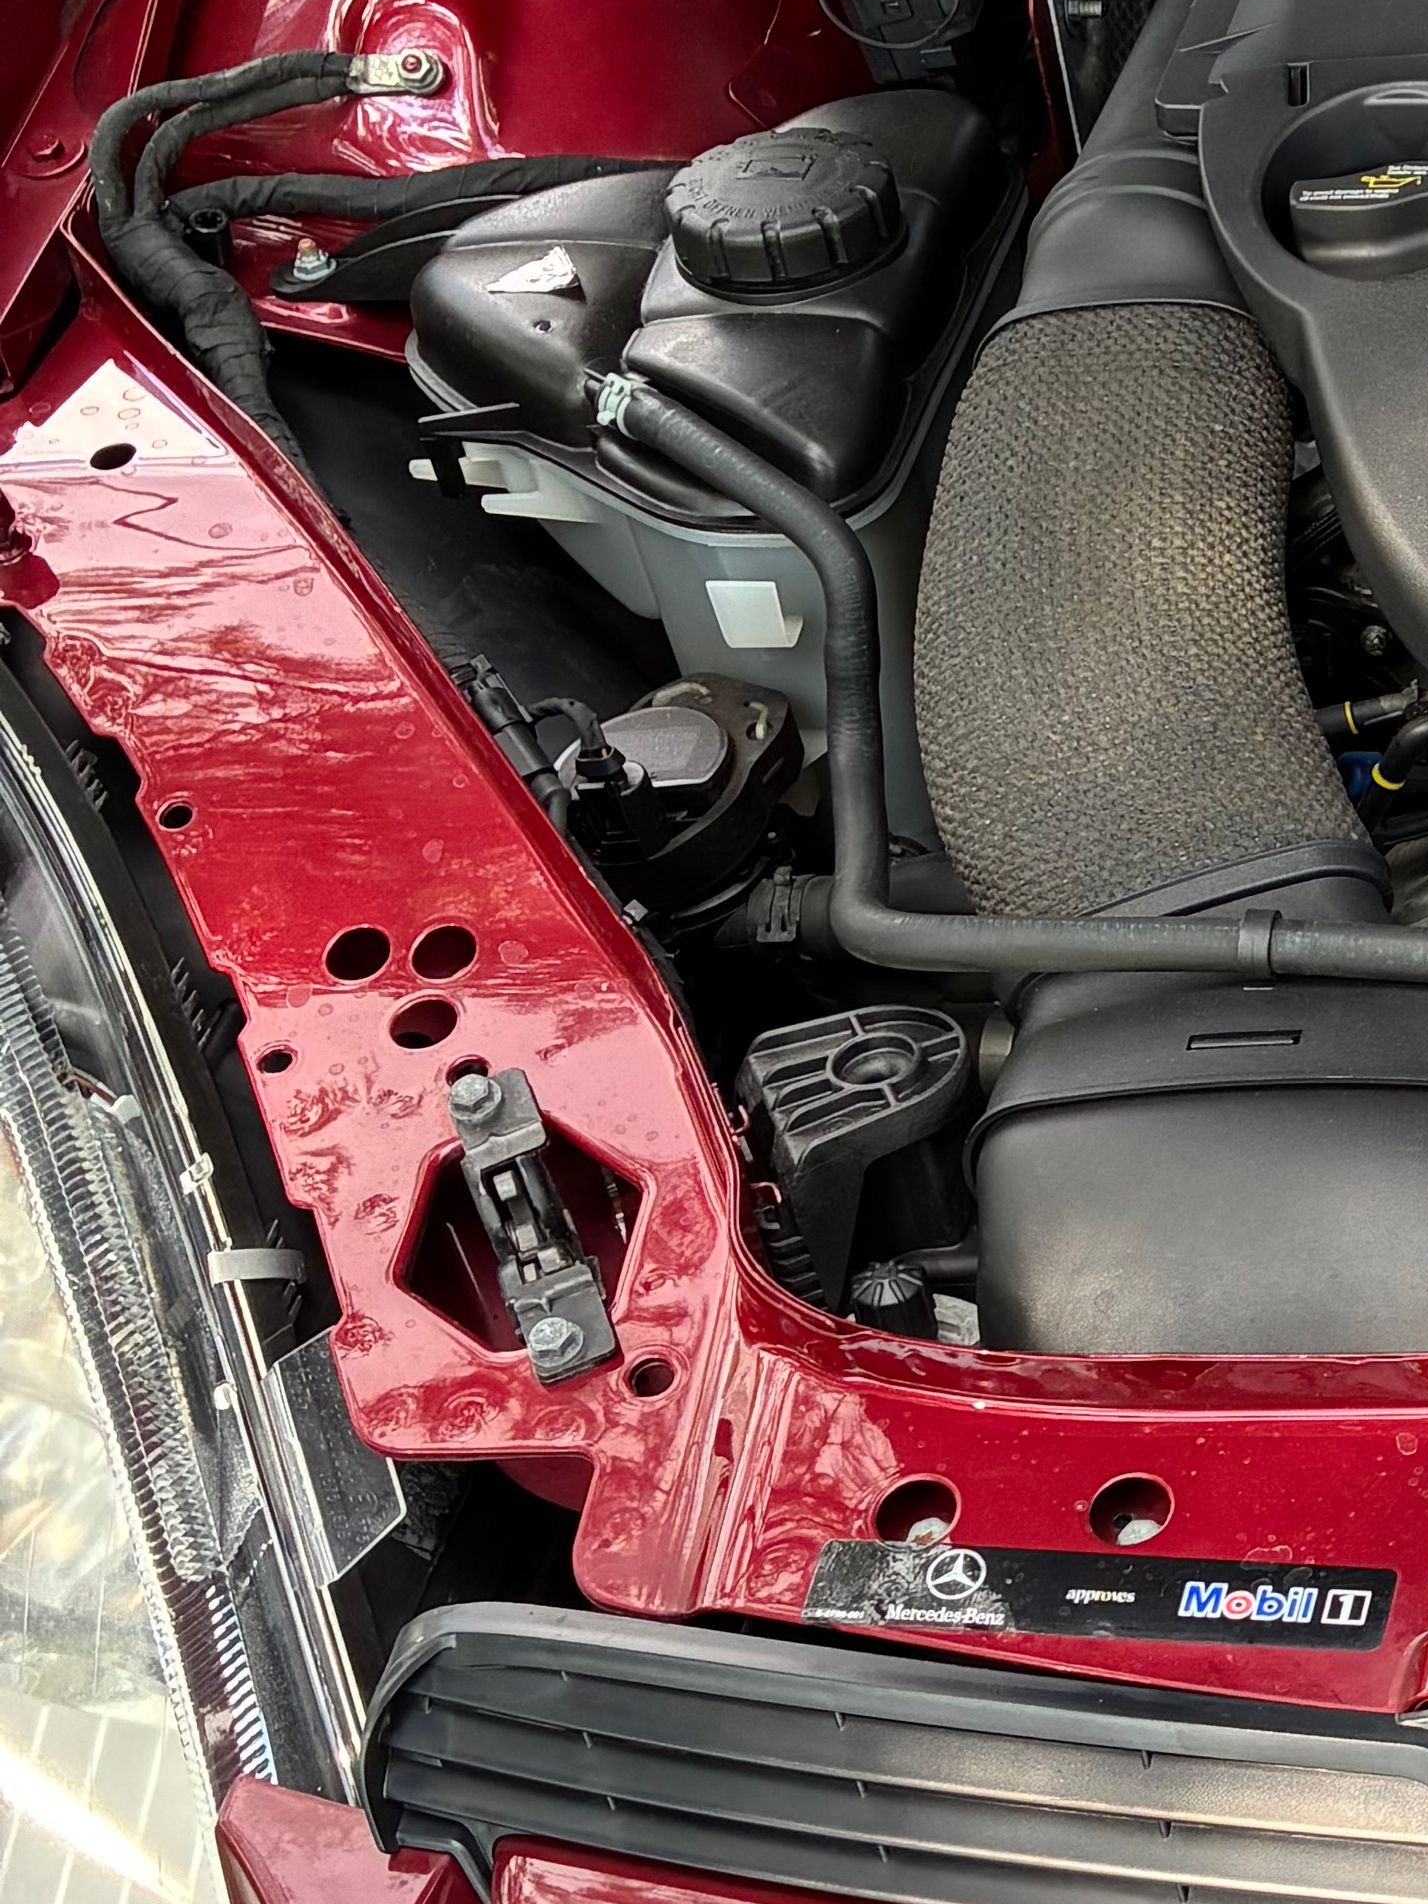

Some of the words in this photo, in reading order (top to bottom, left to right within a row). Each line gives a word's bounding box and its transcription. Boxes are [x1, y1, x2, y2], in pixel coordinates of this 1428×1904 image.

[1065, 1586, 1136, 1605] approves
[1178, 1581, 1319, 1624] Mobil
[885, 1603, 1006, 1627] Mercedes-Benz
